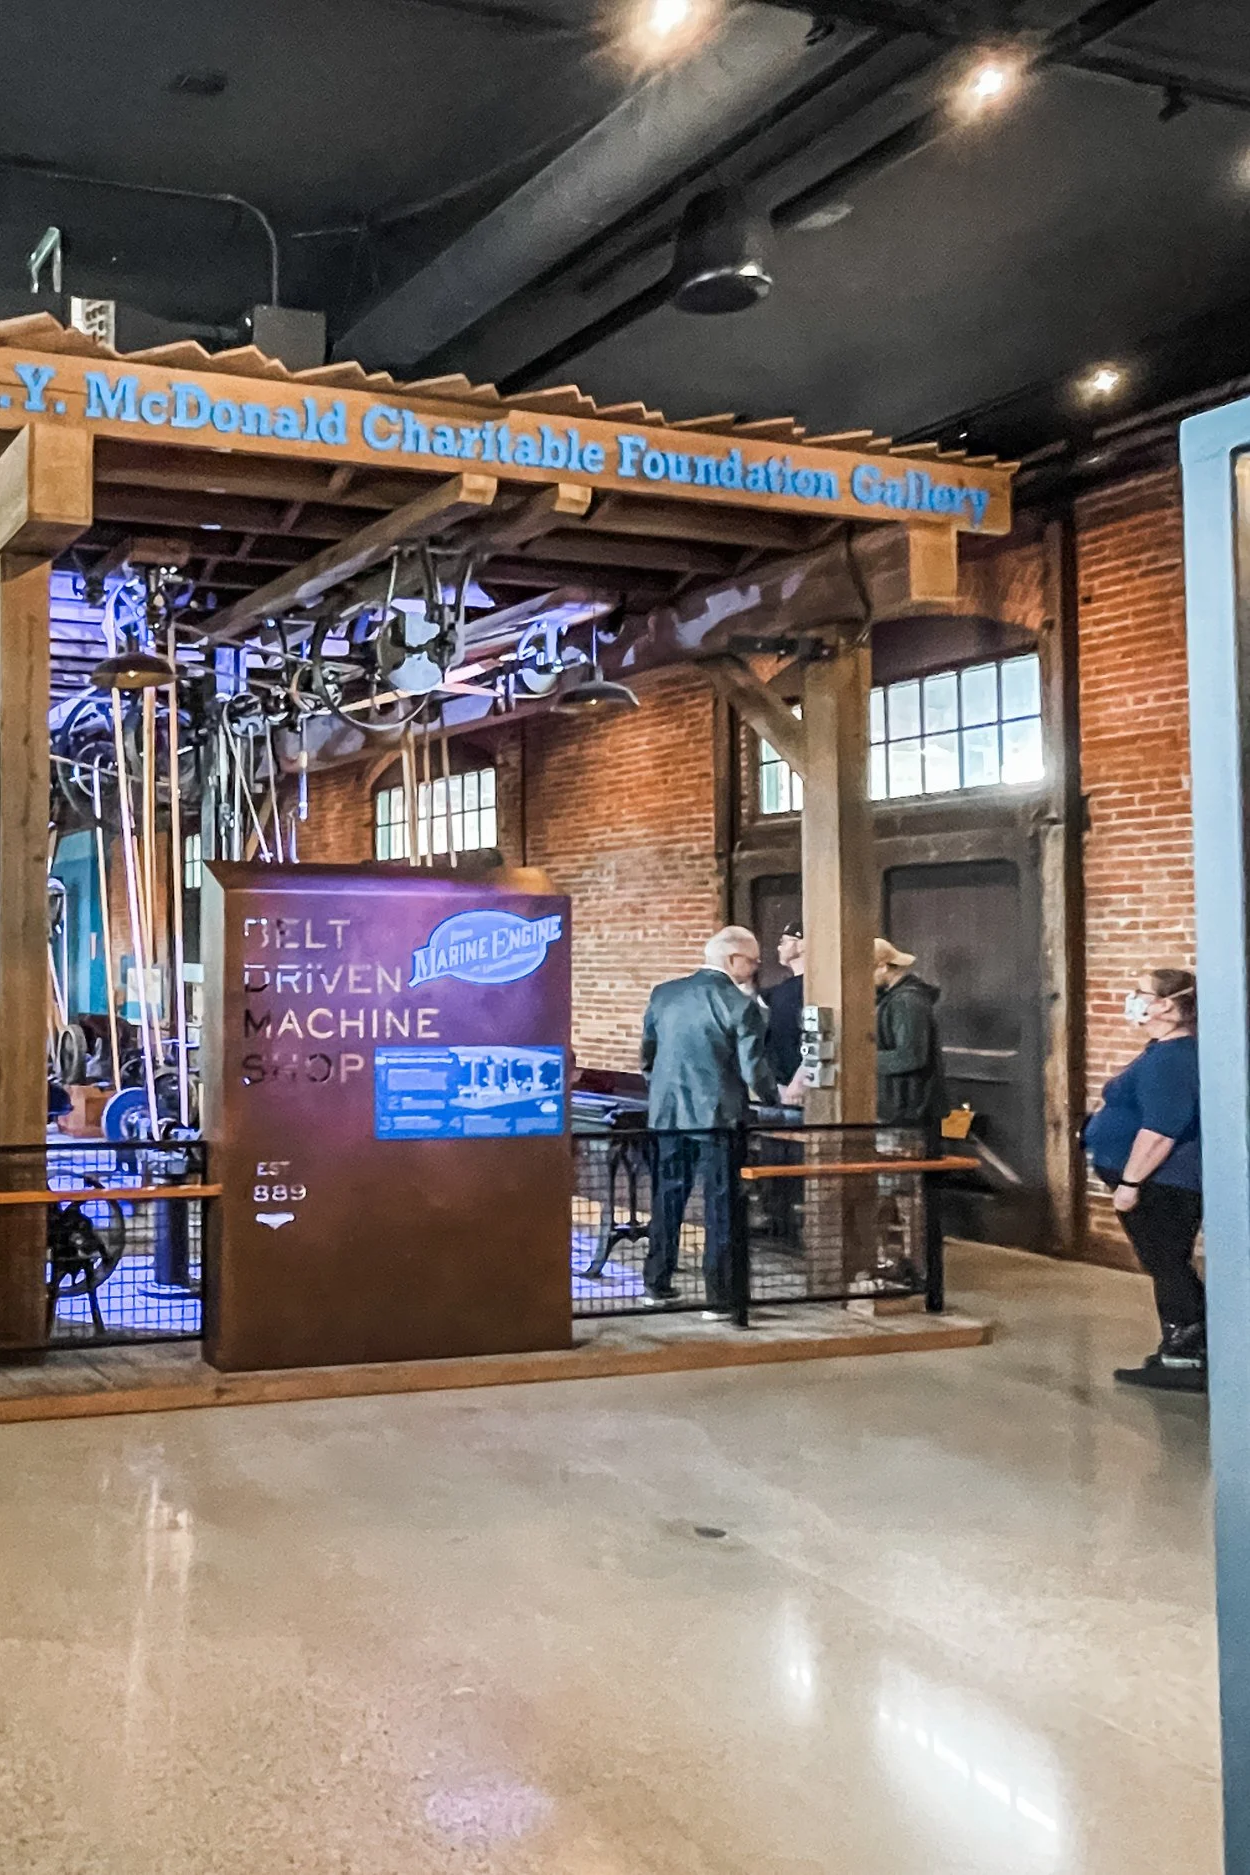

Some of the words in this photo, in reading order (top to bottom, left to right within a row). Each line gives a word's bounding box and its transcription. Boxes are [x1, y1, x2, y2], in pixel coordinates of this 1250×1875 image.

[85, 371, 347, 446] McDonald
[361, 402, 606, 474] Charitable
[616, 433, 840, 500] Foundation
[851, 463, 989, 531] Gallery
[413, 936, 489, 979] MARINE
[491, 914, 562, 960] ENGINE
[243, 961, 403, 994] DRIVEN
[244, 1007, 440, 1039] MACHINE
[241, 1052, 366, 1086] SHOP
